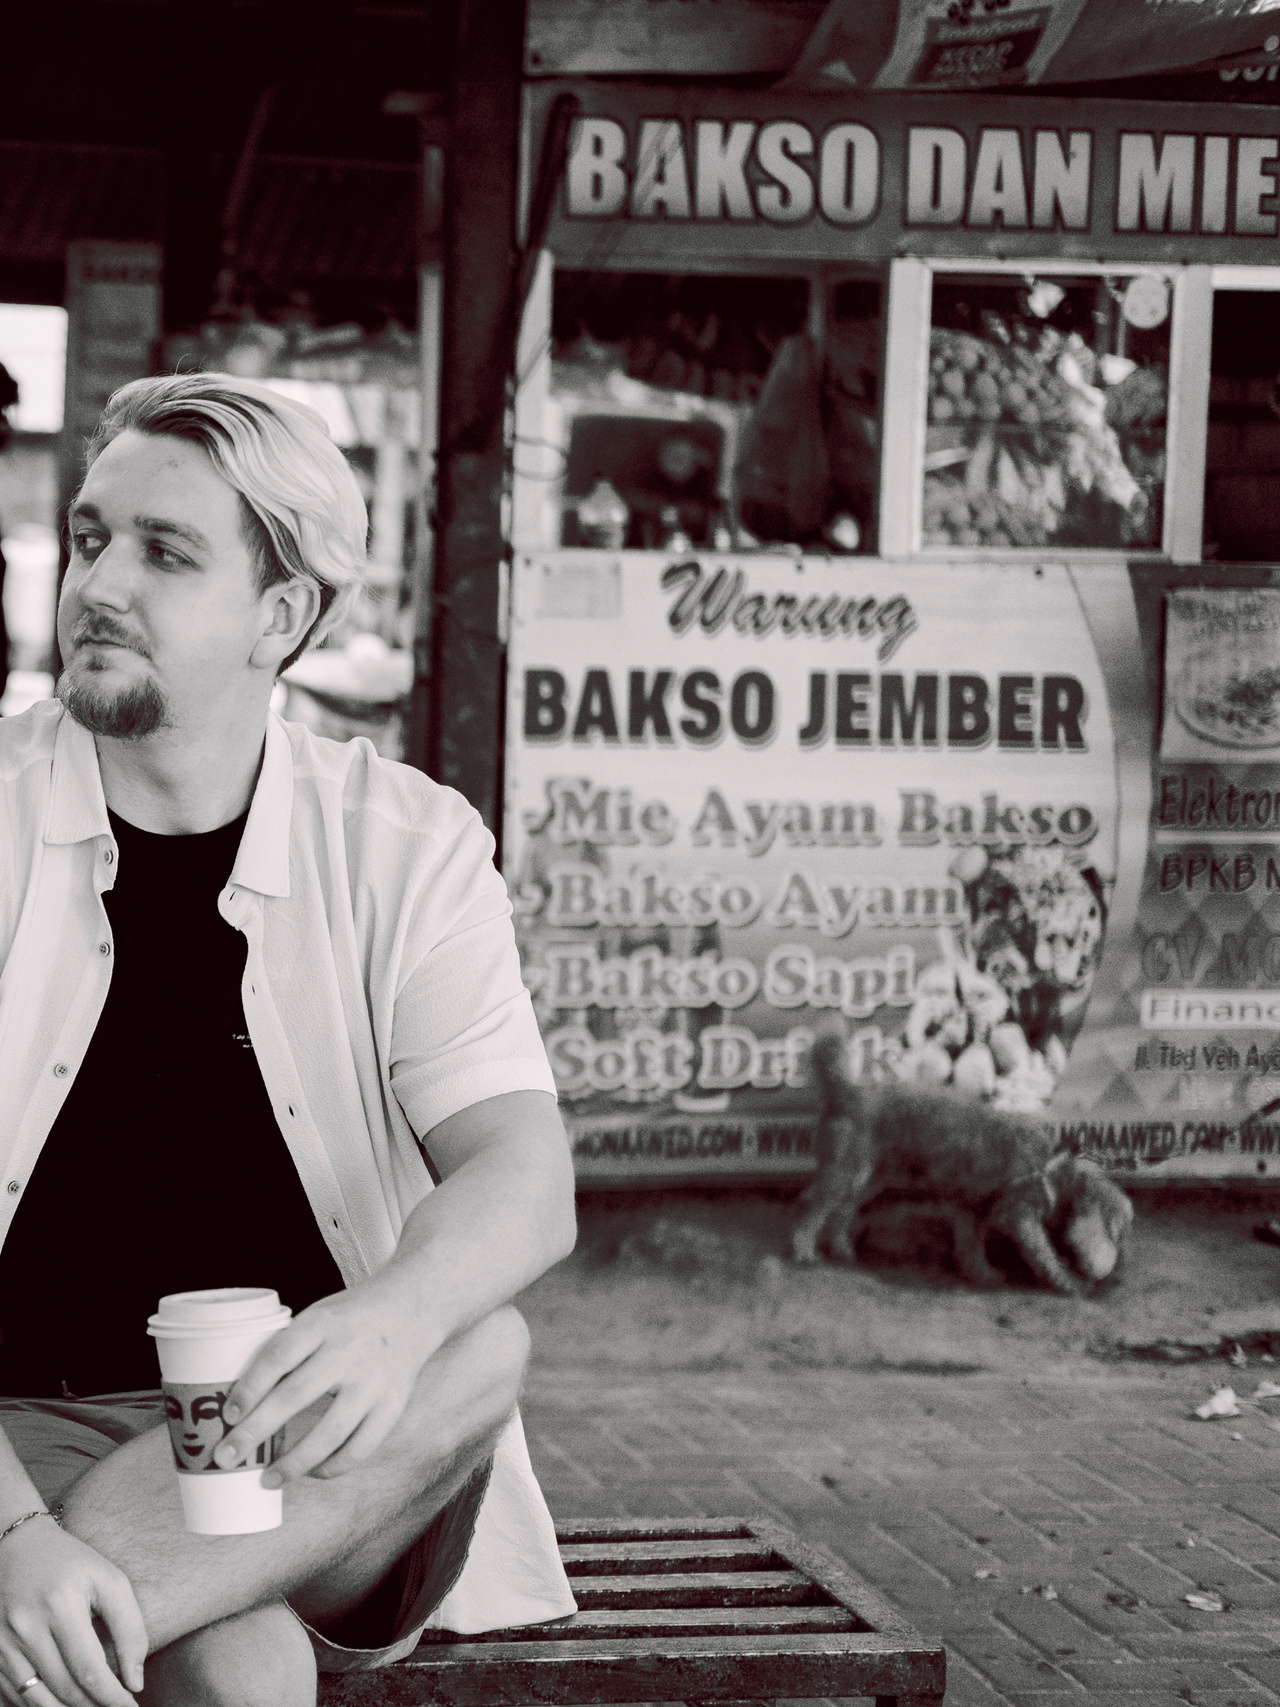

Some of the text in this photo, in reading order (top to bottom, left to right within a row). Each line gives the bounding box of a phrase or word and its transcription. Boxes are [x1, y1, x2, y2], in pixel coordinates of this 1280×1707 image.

[566, 116, 1280, 236] BAKSO DAN MIE
[660, 561, 918, 664] Warung
[522, 667, 1089, 750] BAKSO JEMBER
[552, 785, 1098, 856] Mie Ayam Bakso
[550, 868, 967, 936] Bakso Ayam
[1160, 853, 1257, 892] BPKB
[548, 946, 920, 1016] Bakso Sapi
[547, 1026, 904, 1088] Soft Drik
